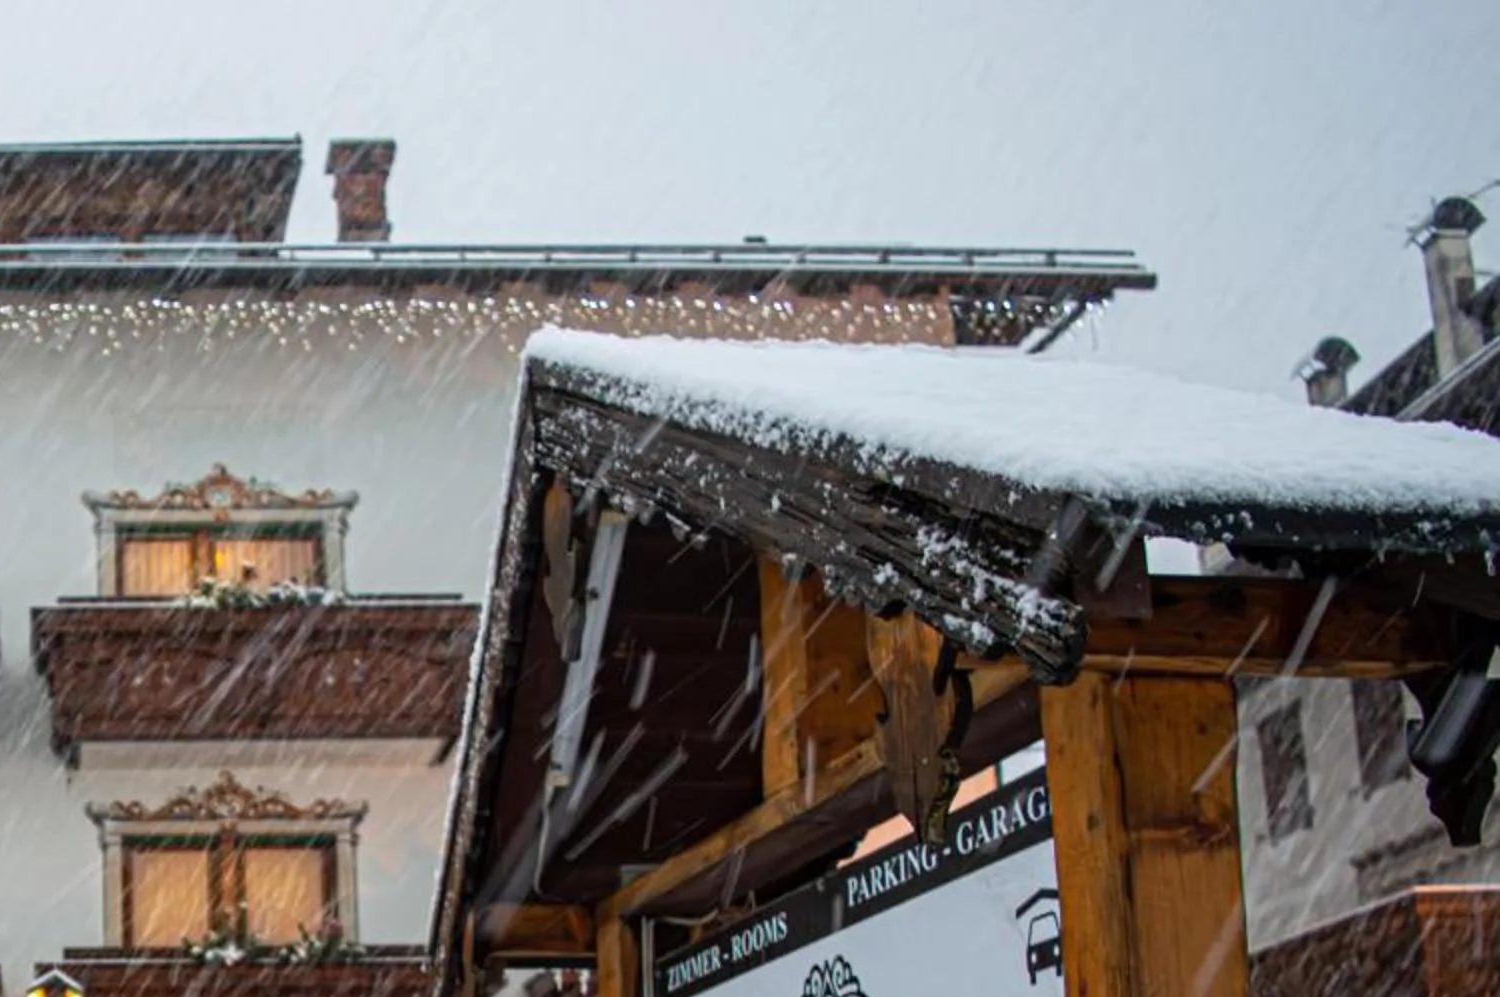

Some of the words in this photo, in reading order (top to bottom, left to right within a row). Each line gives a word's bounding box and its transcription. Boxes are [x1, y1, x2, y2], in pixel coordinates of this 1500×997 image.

[847, 844, 937, 907] PARKING
[956, 785, 1053, 856] GARAG
[667, 945, 721, 992] ZIMMER
[731, 911, 788, 962] ROOMS
